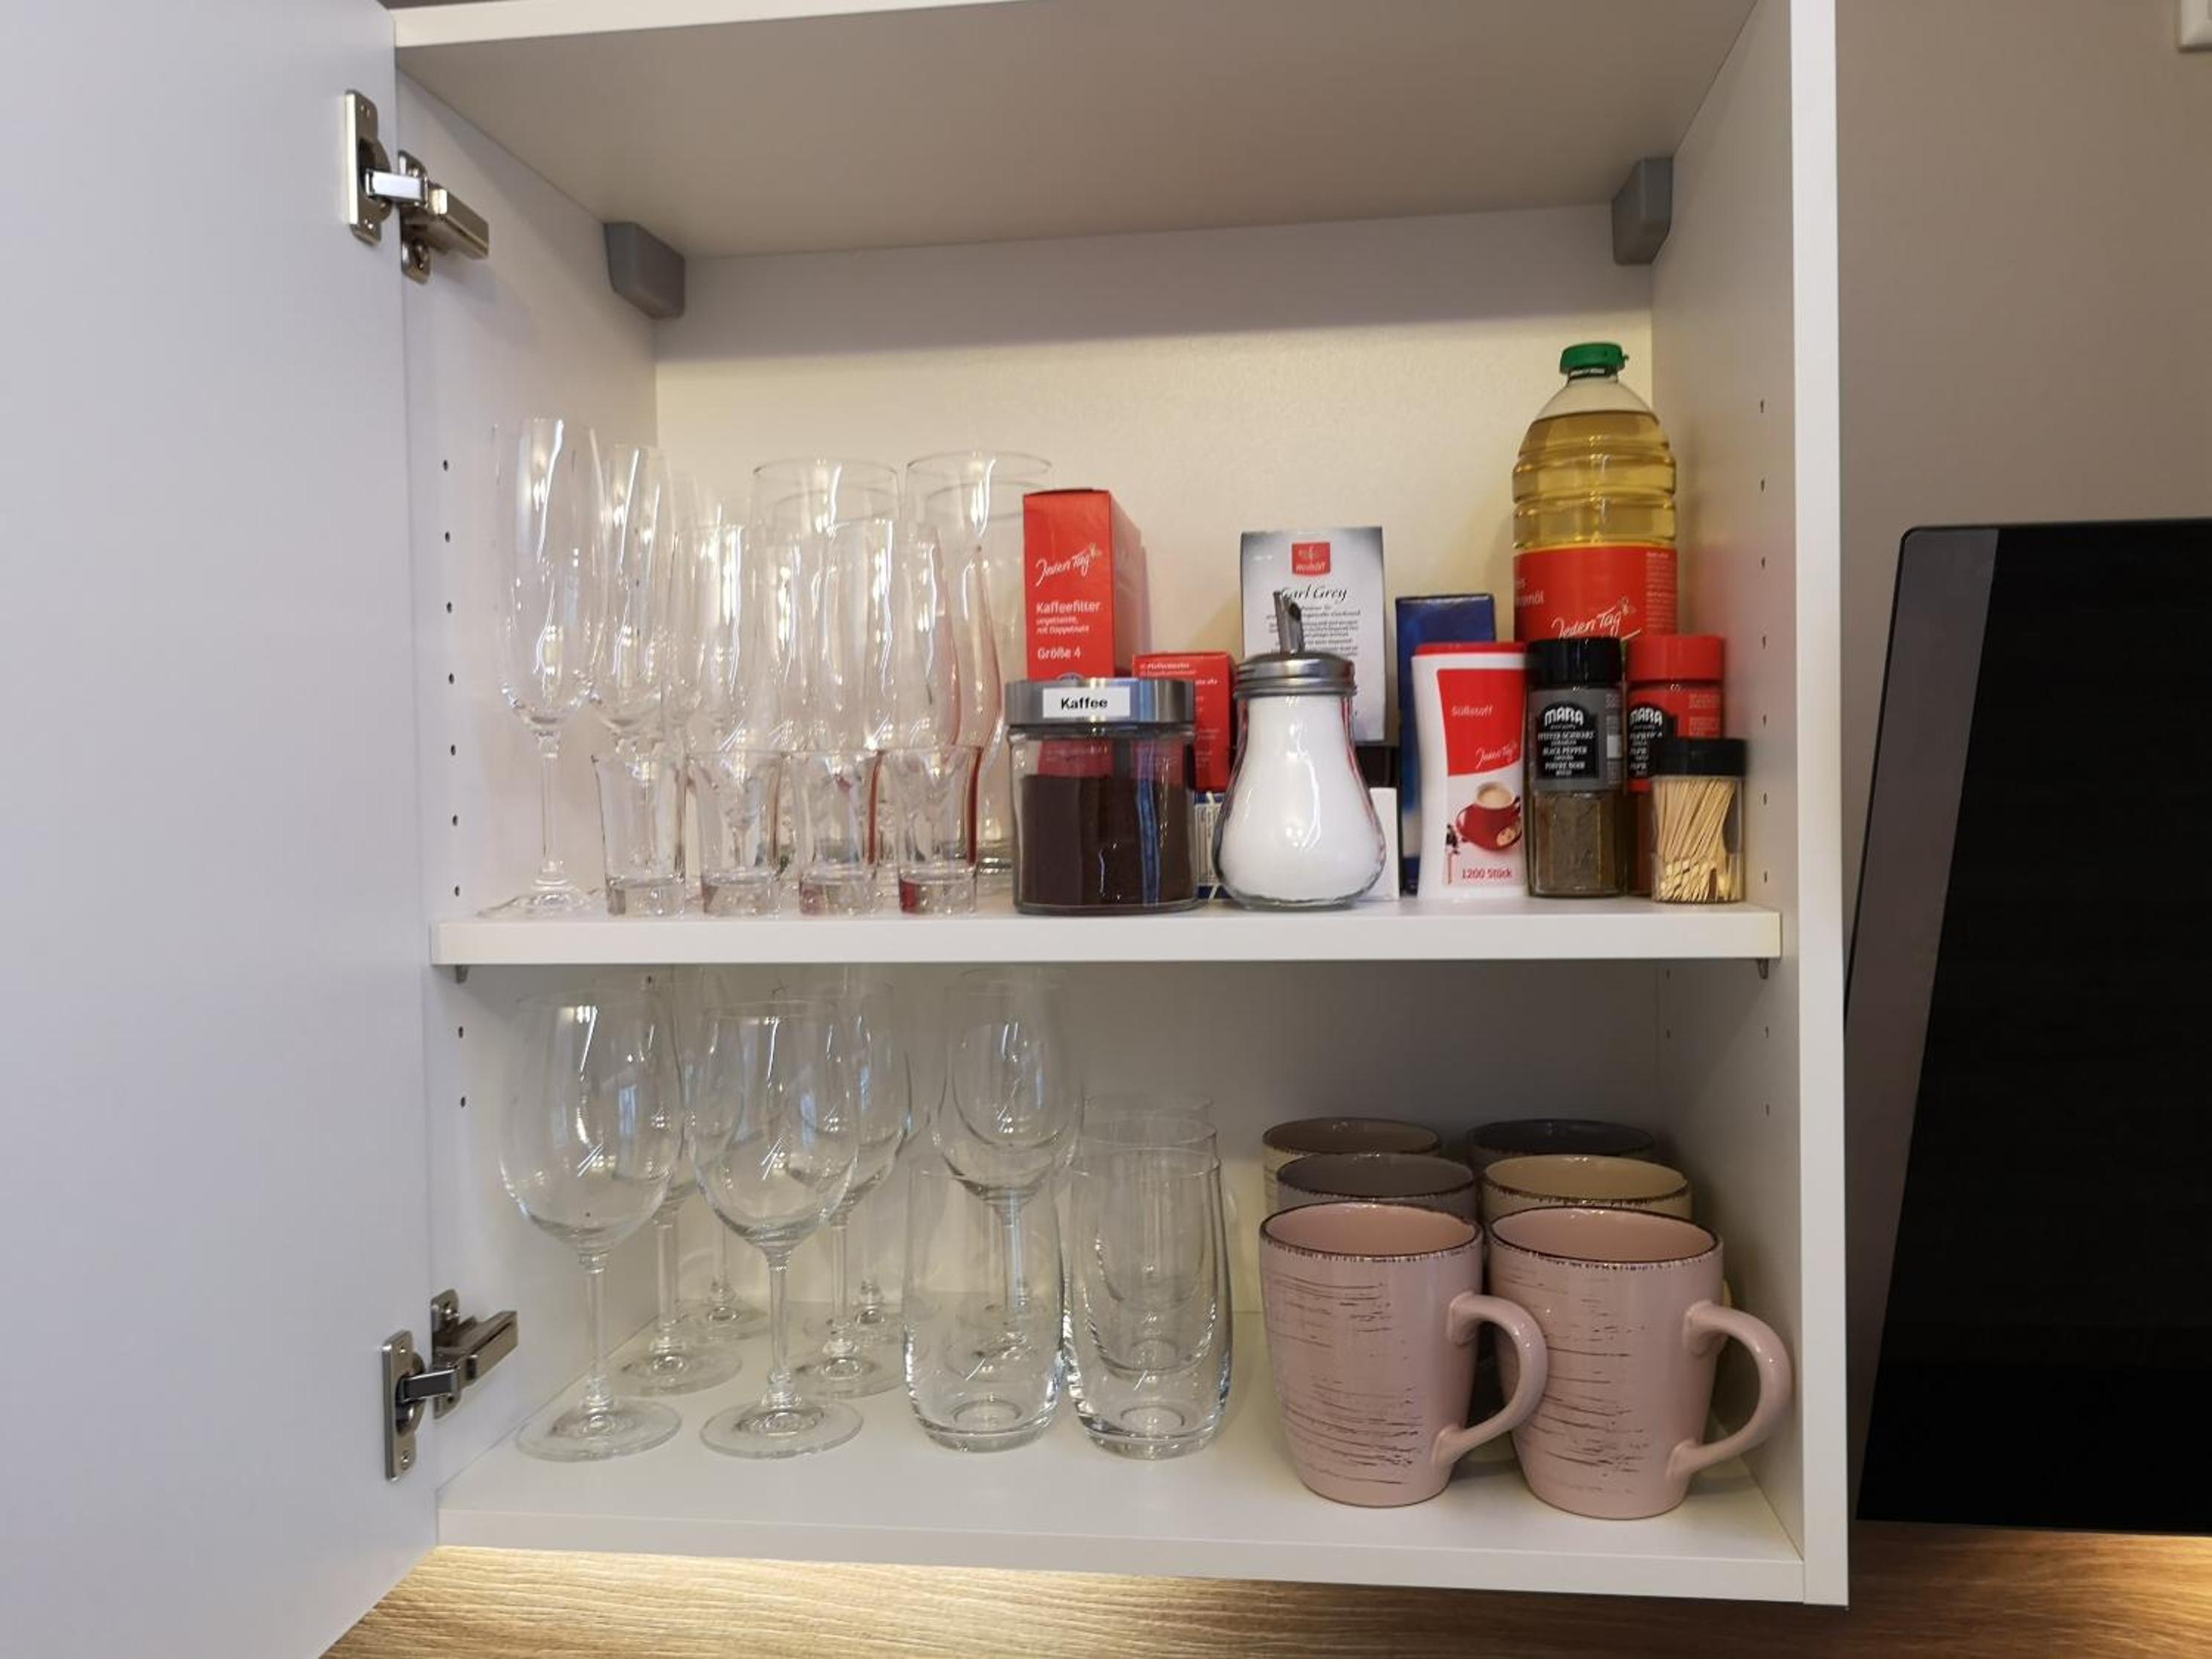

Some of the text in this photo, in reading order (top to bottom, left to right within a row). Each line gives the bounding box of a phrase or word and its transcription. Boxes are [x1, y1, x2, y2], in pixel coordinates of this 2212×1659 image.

[1035, 549, 1091, 587] Jeden Tag
[1313, 586, 1348, 604] Grey
[1036, 600, 1101, 614] Kaffeefilter
[1550, 605, 1622, 640] Jeden Tag
[1037, 645, 1081, 660] Größe 4
[1060, 696, 1108, 710] Kaffee
[1452, 704, 1493, 717] Süßstoff
[1545, 705, 1584, 726] MARA
[1461, 865, 1512, 879] 1200 Stück
